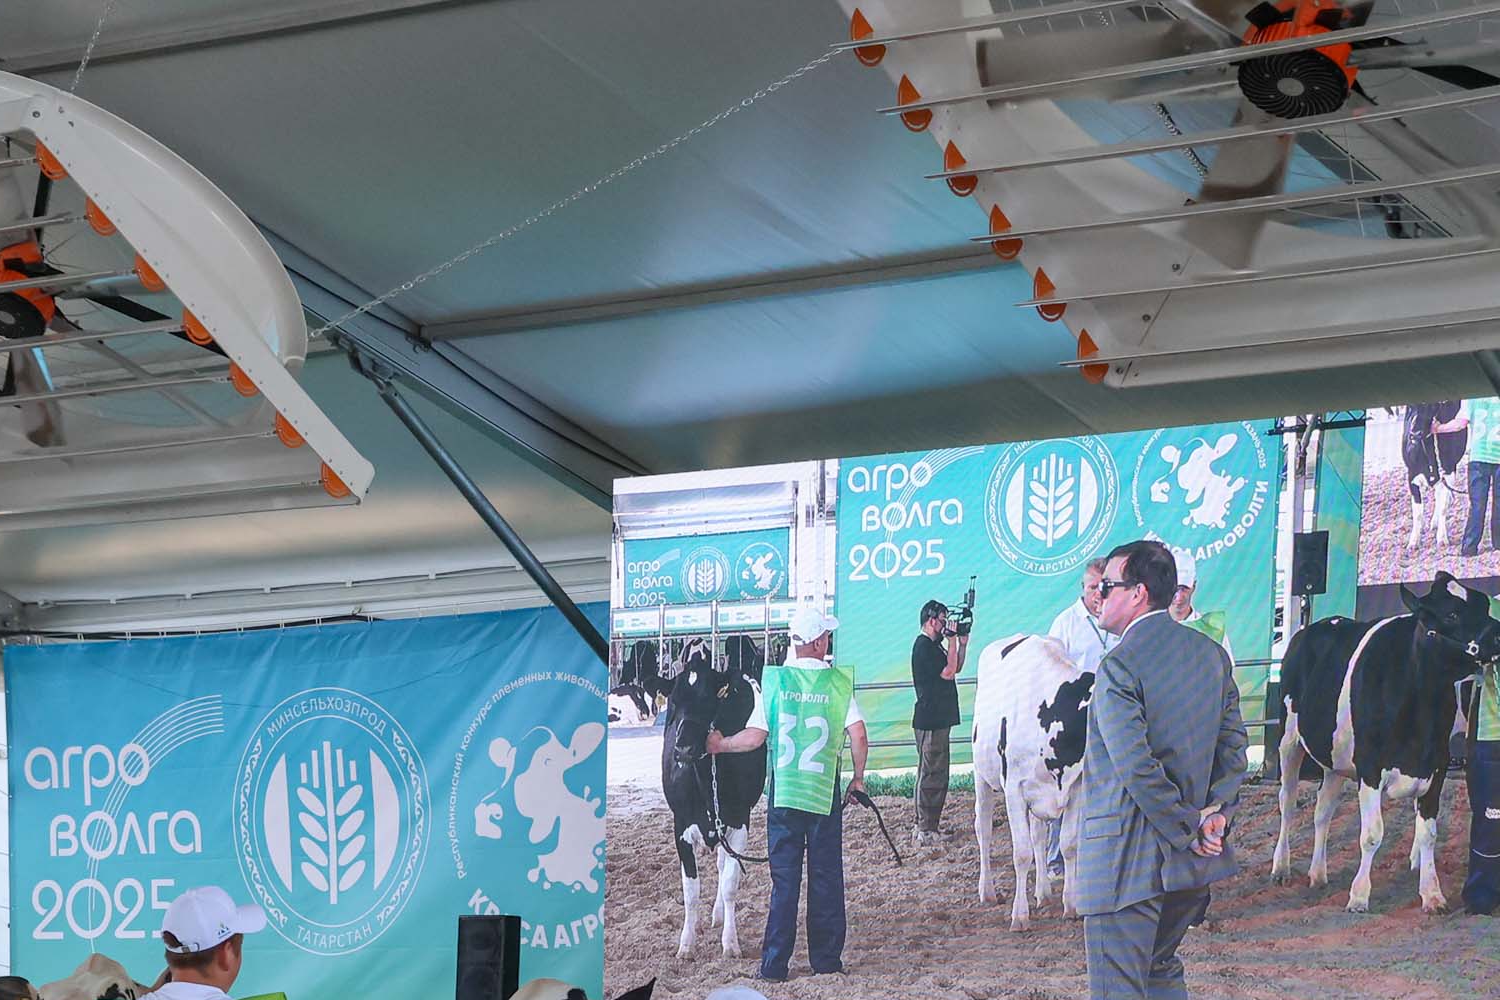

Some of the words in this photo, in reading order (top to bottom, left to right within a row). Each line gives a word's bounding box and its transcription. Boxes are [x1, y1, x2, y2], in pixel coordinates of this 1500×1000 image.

[848, 461, 932, 500] агро
[861, 498, 963, 532] волга
[1195, 480, 1269, 561] АГРОВОЛГИ
[627, 560, 661, 577] агро
[849, 539, 946, 581] 2025
[1022, 556, 1078, 573] ТАТАРСТАН
[267, 696, 387, 738] МИНСЕЛЬХОЗПРОД
[777, 712, 829, 774] 32
[23, 743, 152, 805] агро
[448, 752, 467, 879] Республиканский
[461, 703, 493, 751] конкурс
[492, 671, 552, 703] племенных
[50, 810, 202, 858] волга
[297, 922, 372, 949] ТАТАРСТАН
